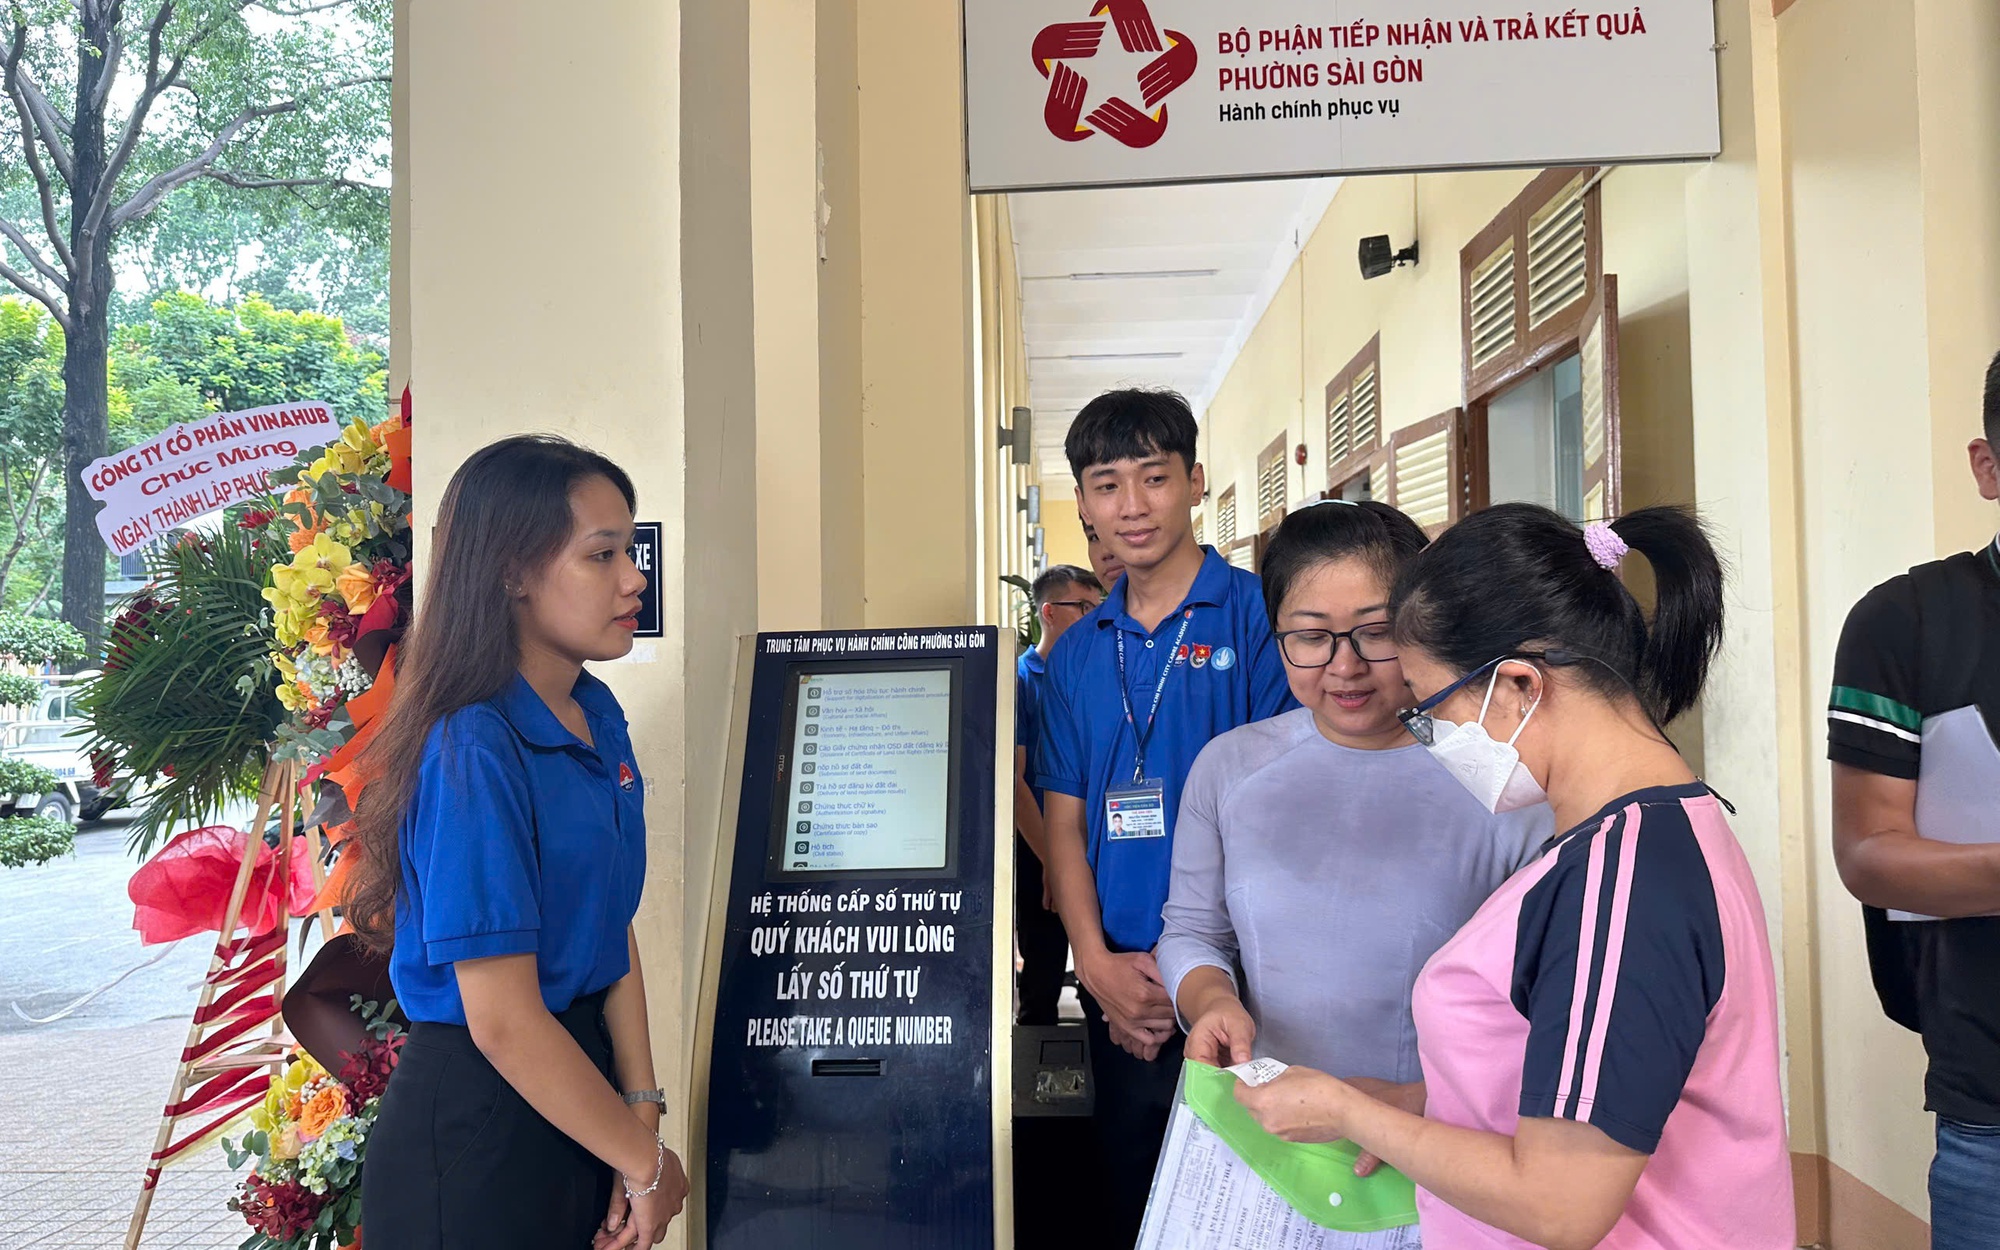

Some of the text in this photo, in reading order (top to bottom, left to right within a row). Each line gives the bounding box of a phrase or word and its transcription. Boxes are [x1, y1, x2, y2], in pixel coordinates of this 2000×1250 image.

[1218, 7, 1646, 58] BỘ PHẬN TIẾP NHẬN VÀ TRẢ KẾT QUẢ
[1219, 55, 1423, 91] PHƯỜNG SÀI GÒN
[1219, 98, 1400, 122] Hành chính phục vụ
[91, 407, 330, 492] CÔNG TY CỔ PHẦN VINAHUB
[140, 440, 298, 496] Chúc Mừng
[111, 513, 154, 553] NGÀY
[152, 491, 206, 530] THÀNH
[207, 480, 232, 508] LẬP
[635, 543, 651, 570] XE
[766, 638, 792, 653] TRUNG
[793, 635, 810, 653] TÂM
[811, 637, 833, 655] PHỤC
[835, 637, 846, 655] VỤ
[847, 633, 869, 651] HÀNH
[870, 633, 895, 651] CHÍNH
[920, 631, 952, 650] PHƯỜNG
[954, 630, 967, 648] SÀI
[969, 630, 985, 648] GÒN
[750, 887, 962, 917] HỆ THỐNG CẤP SỐ THỨ TỰ
[751, 919, 955, 957] QUÝ KHÁCH VUI LÒNG
[777, 961, 921, 1004] LẤY SỐ THỨ TỰ
[747, 1016, 952, 1048] PLEASE TAKE A QUEUE NUMBER
